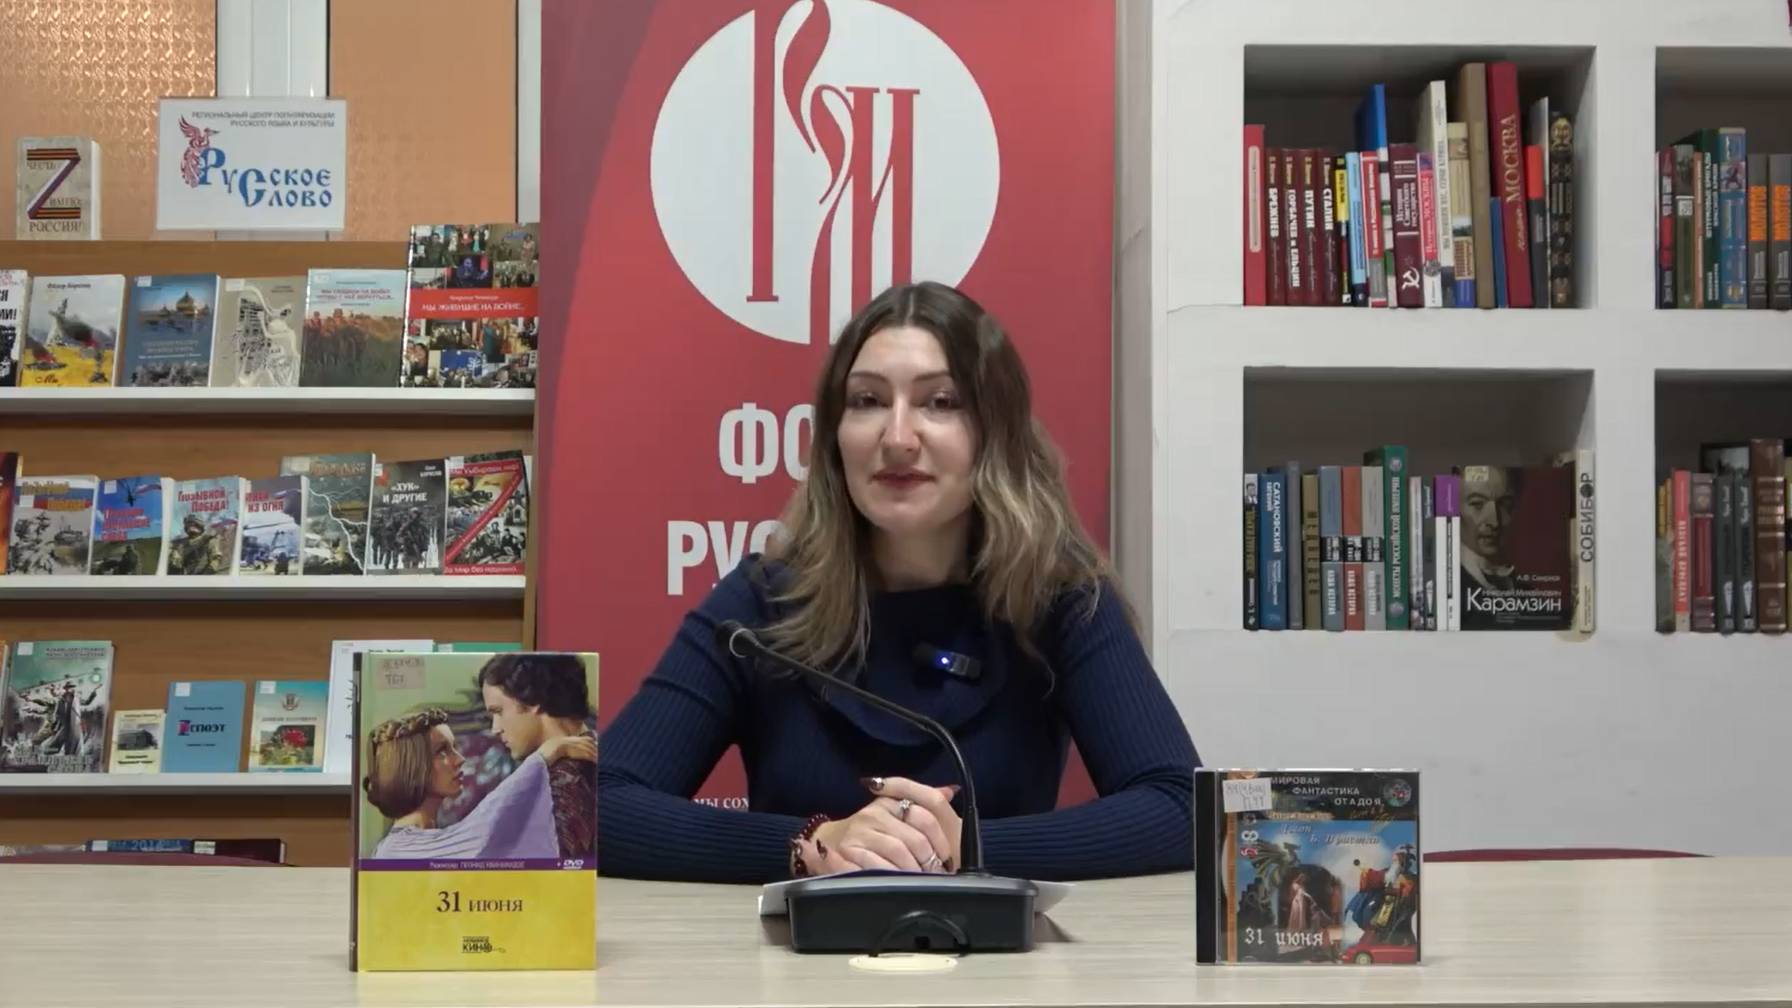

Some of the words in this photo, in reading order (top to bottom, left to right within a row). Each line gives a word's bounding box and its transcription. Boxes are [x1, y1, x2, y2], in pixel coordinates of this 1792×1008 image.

[1501, 114, 1521, 203] МОСКВА
[1268, 188, 1279, 237] БРЕЖНЕВ
[1304, 190, 1315, 228] ПУТИН
[1324, 188, 1334, 230] СТАЛИН
[1291, 249, 1300, 288] ЕЛЬЦИН
[382, 494, 390, 504] И
[392, 492, 428, 504] ДРУГИЕ
[1273, 482, 1283, 552] САТАНОВСКИЙ
[1392, 566, 1400, 598] МОНЕТЫ
[1467, 588, 1562, 614] Карамзин
[1292, 786, 1360, 796] ФАНТАСТИКА
[436, 891, 462, 913] 31
[1244, 928, 1264, 945] 31
